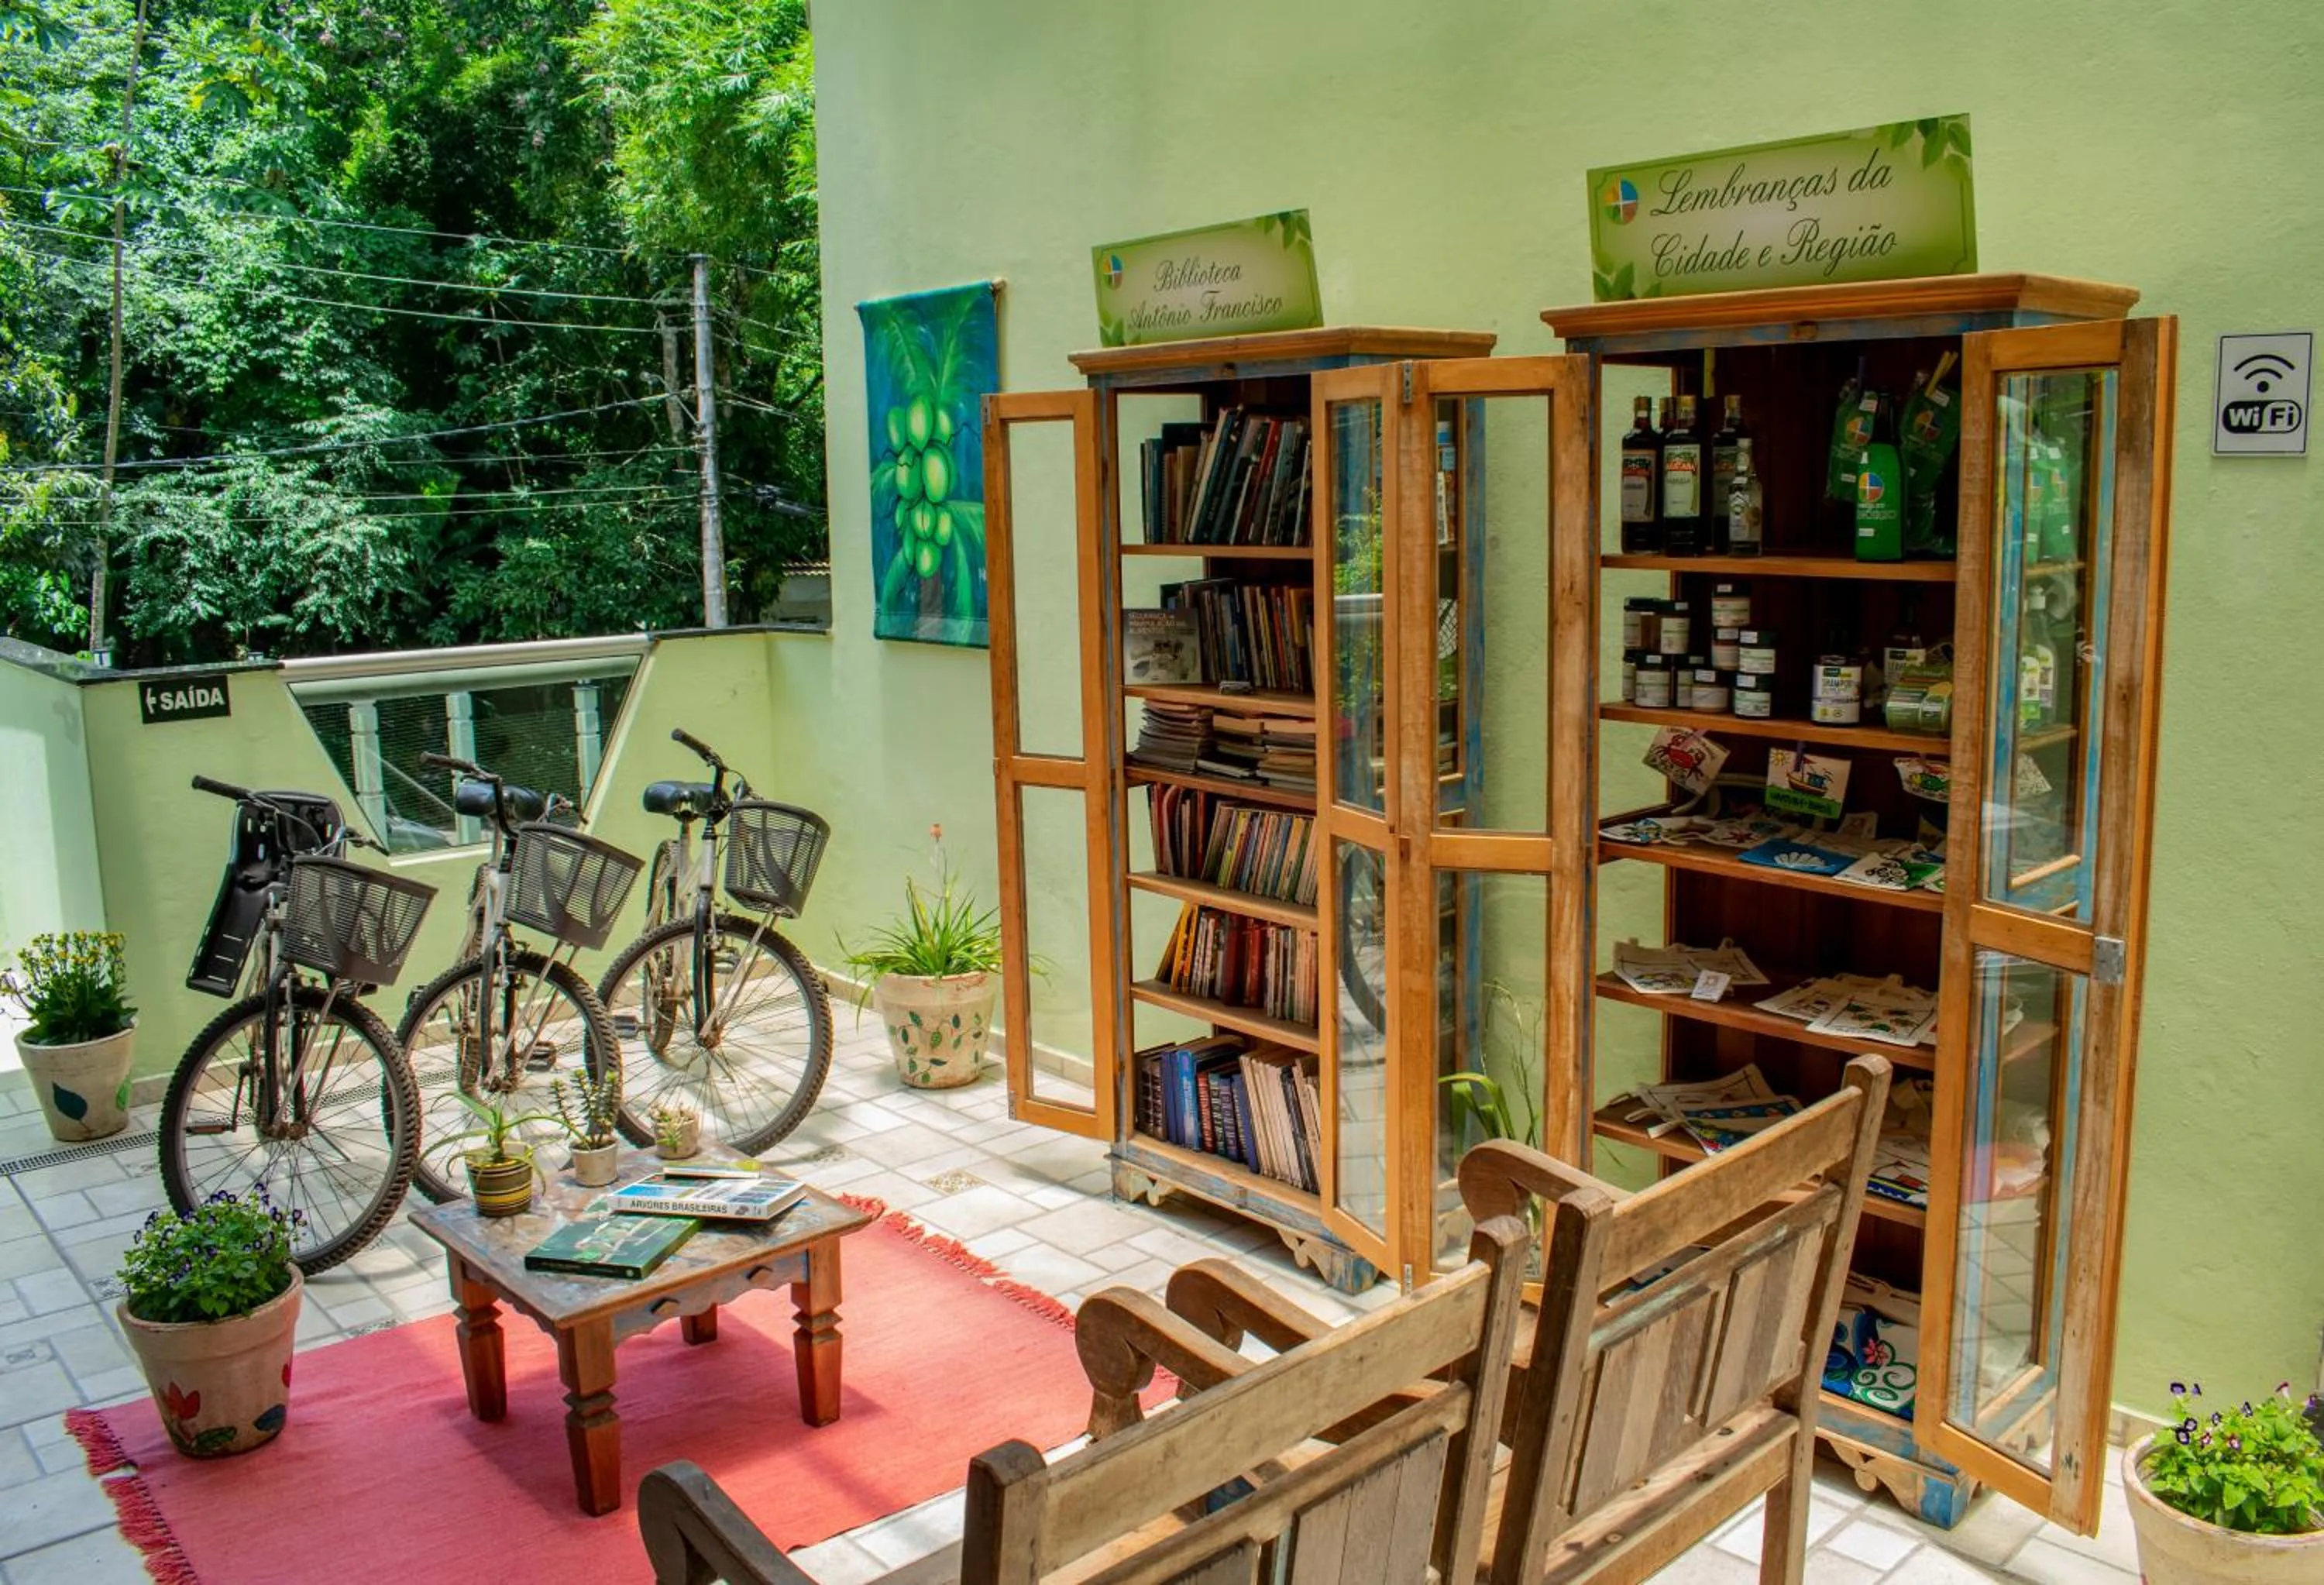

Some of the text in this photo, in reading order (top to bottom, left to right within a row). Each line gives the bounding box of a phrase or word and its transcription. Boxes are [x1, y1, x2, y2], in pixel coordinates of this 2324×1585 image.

[1649, 147, 1893, 217] Lembranças da
[1651, 218, 1898, 279] Cidade e Região
[1153, 256, 1242, 292] Biblioteca
[1127, 290, 1283, 330] Antônio Francisco
[160, 685, 225, 710] SAÍDA
[672, 1202, 727, 1214] BRASILEIRAS
